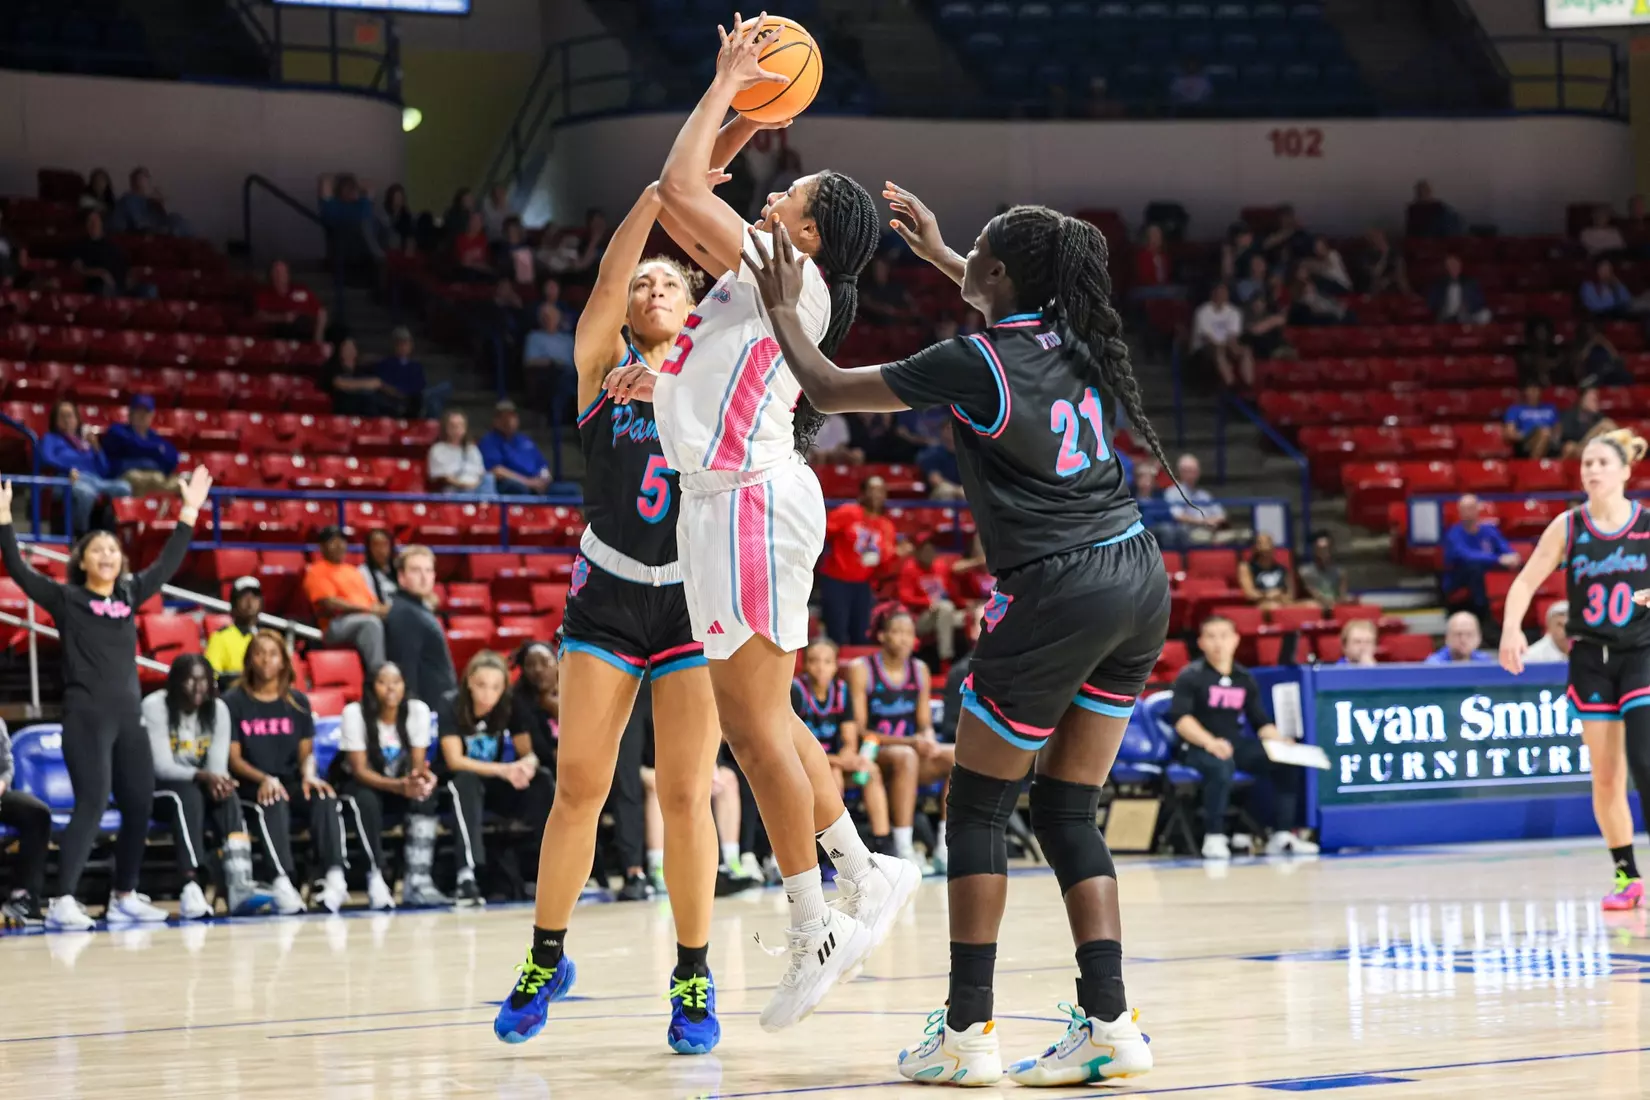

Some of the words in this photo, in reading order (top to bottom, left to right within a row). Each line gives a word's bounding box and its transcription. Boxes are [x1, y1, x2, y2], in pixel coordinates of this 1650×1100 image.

[1267, 127, 1325, 158] 102
[1050, 386, 1110, 477] 21
[637, 454, 676, 524] 5
[1582, 582, 1635, 628] 30
[1334, 700, 1447, 746] Ivan
[1460, 689, 1584, 741] Smit
